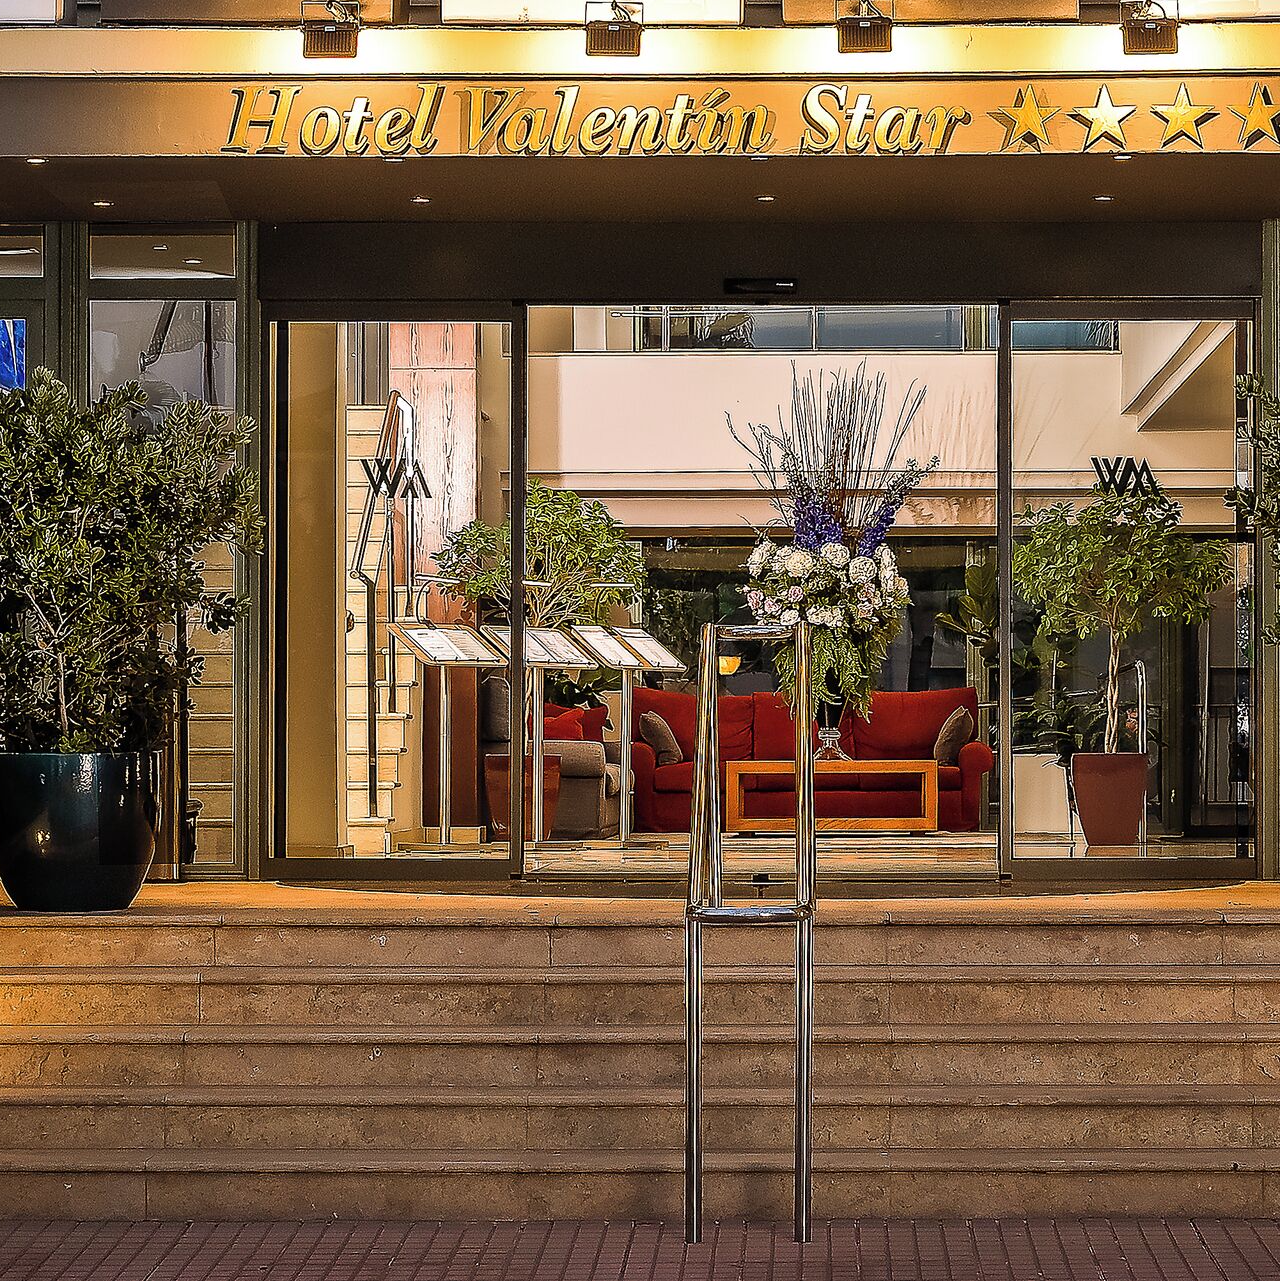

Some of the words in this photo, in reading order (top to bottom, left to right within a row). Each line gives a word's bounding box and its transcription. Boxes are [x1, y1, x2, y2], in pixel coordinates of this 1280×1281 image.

[223, 83, 443, 153] Hotel
[460, 83, 773, 153] Valentín
[801, 83, 970, 153] Star
